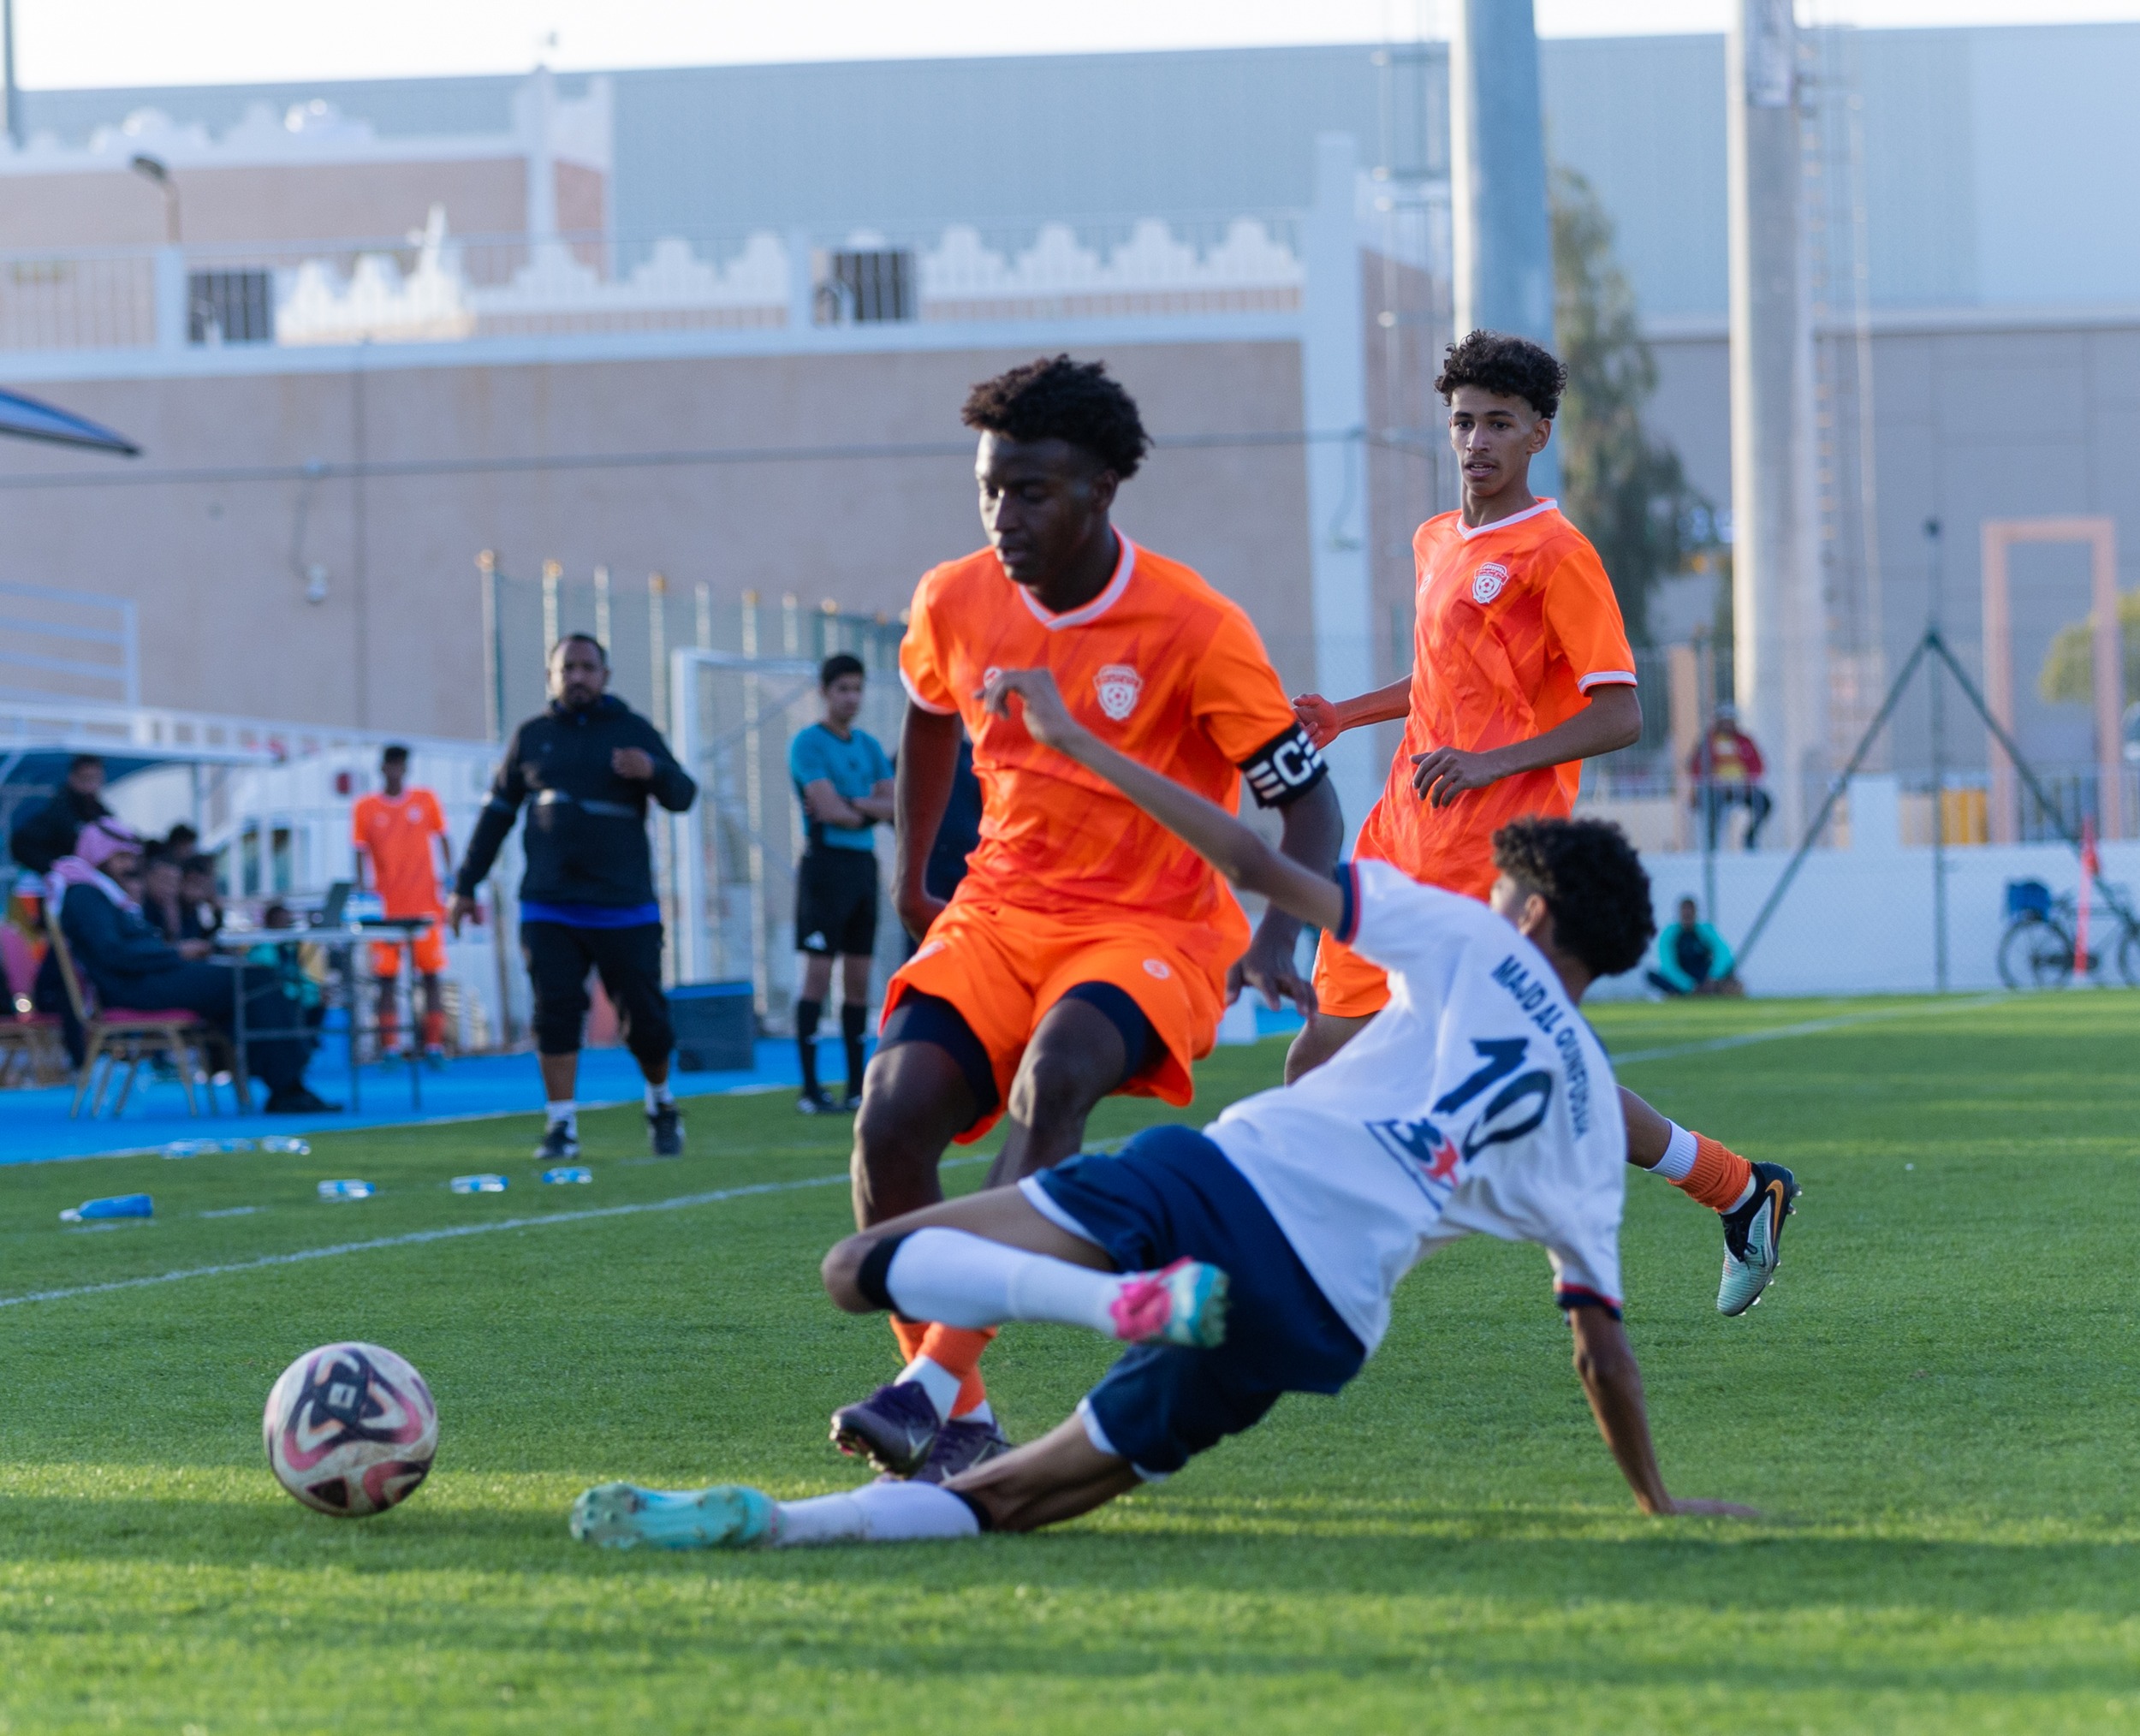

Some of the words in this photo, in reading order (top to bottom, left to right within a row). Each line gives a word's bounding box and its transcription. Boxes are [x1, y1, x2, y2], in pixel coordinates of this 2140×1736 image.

[1272, 740, 1313, 786] C
[1490, 954, 1548, 1013] MAJD
[1530, 1002, 1565, 1035] AL
[1430, 1037, 1554, 1163] 10
